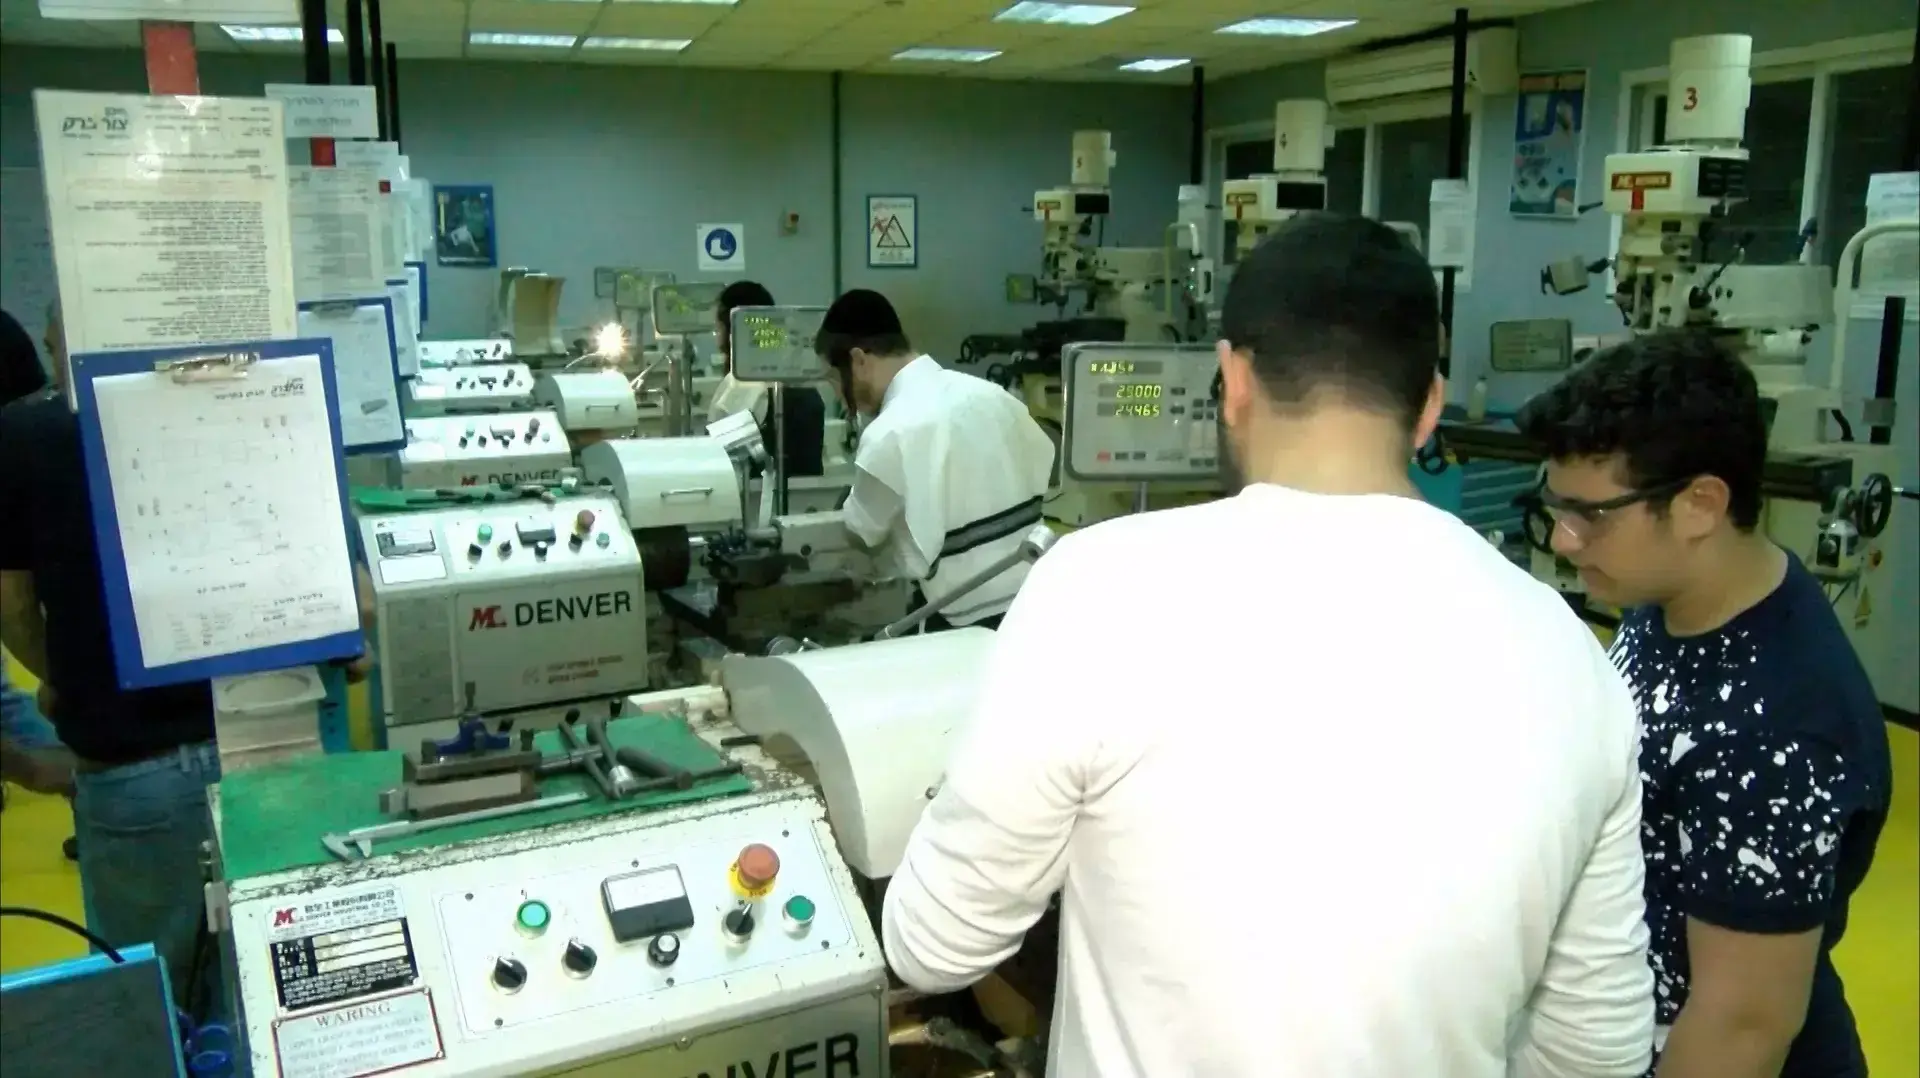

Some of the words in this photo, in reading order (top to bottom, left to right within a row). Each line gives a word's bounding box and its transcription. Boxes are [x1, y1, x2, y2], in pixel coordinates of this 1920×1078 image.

[1683, 86, 1698, 110] 3
[515, 590, 632, 627] DENVER
[315, 1001, 392, 1028] WARING
